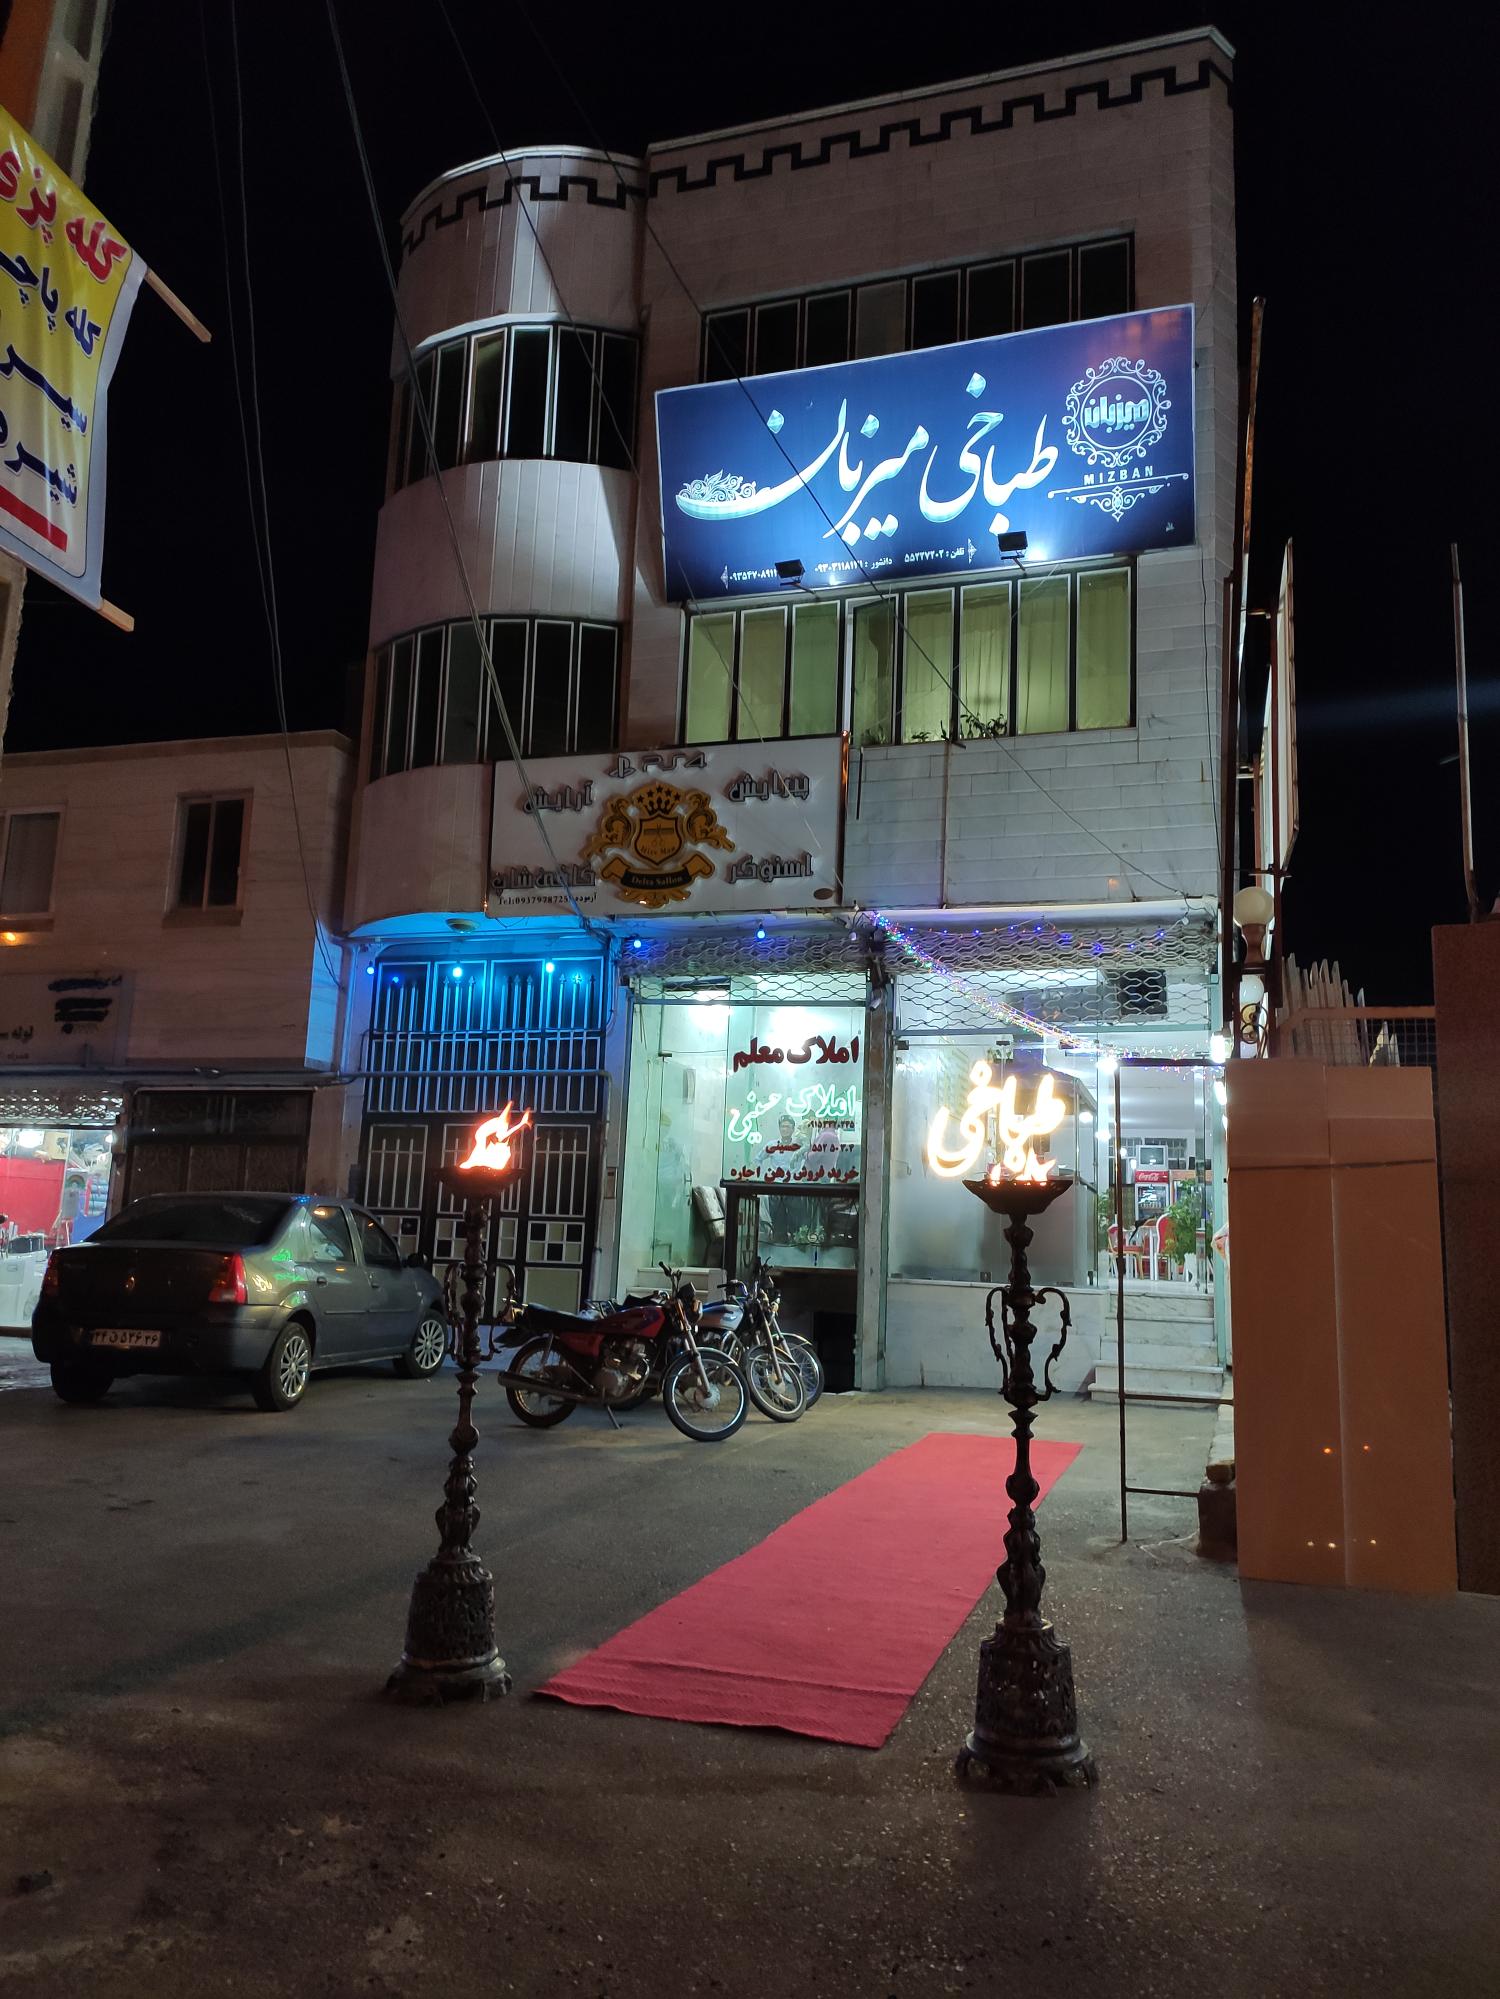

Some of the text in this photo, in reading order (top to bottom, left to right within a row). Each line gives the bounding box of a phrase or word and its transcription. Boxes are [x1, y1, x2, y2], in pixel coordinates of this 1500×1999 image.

[65, 216, 127, 282] کله
[65, 305, 101, 357] کله
[1084, 393, 1150, 433] میزبان
[676, 371, 1059, 547] طباخی میزبان
[1083, 465, 1154, 486] MIZBAN
[733, 1035, 859, 1073] املاک معلم
[785, 1083, 857, 1118] املاک
[765, 1140, 801, 1154] حسینی
[730, 1165, 860, 1184] خرید فروش رهن اجاره
